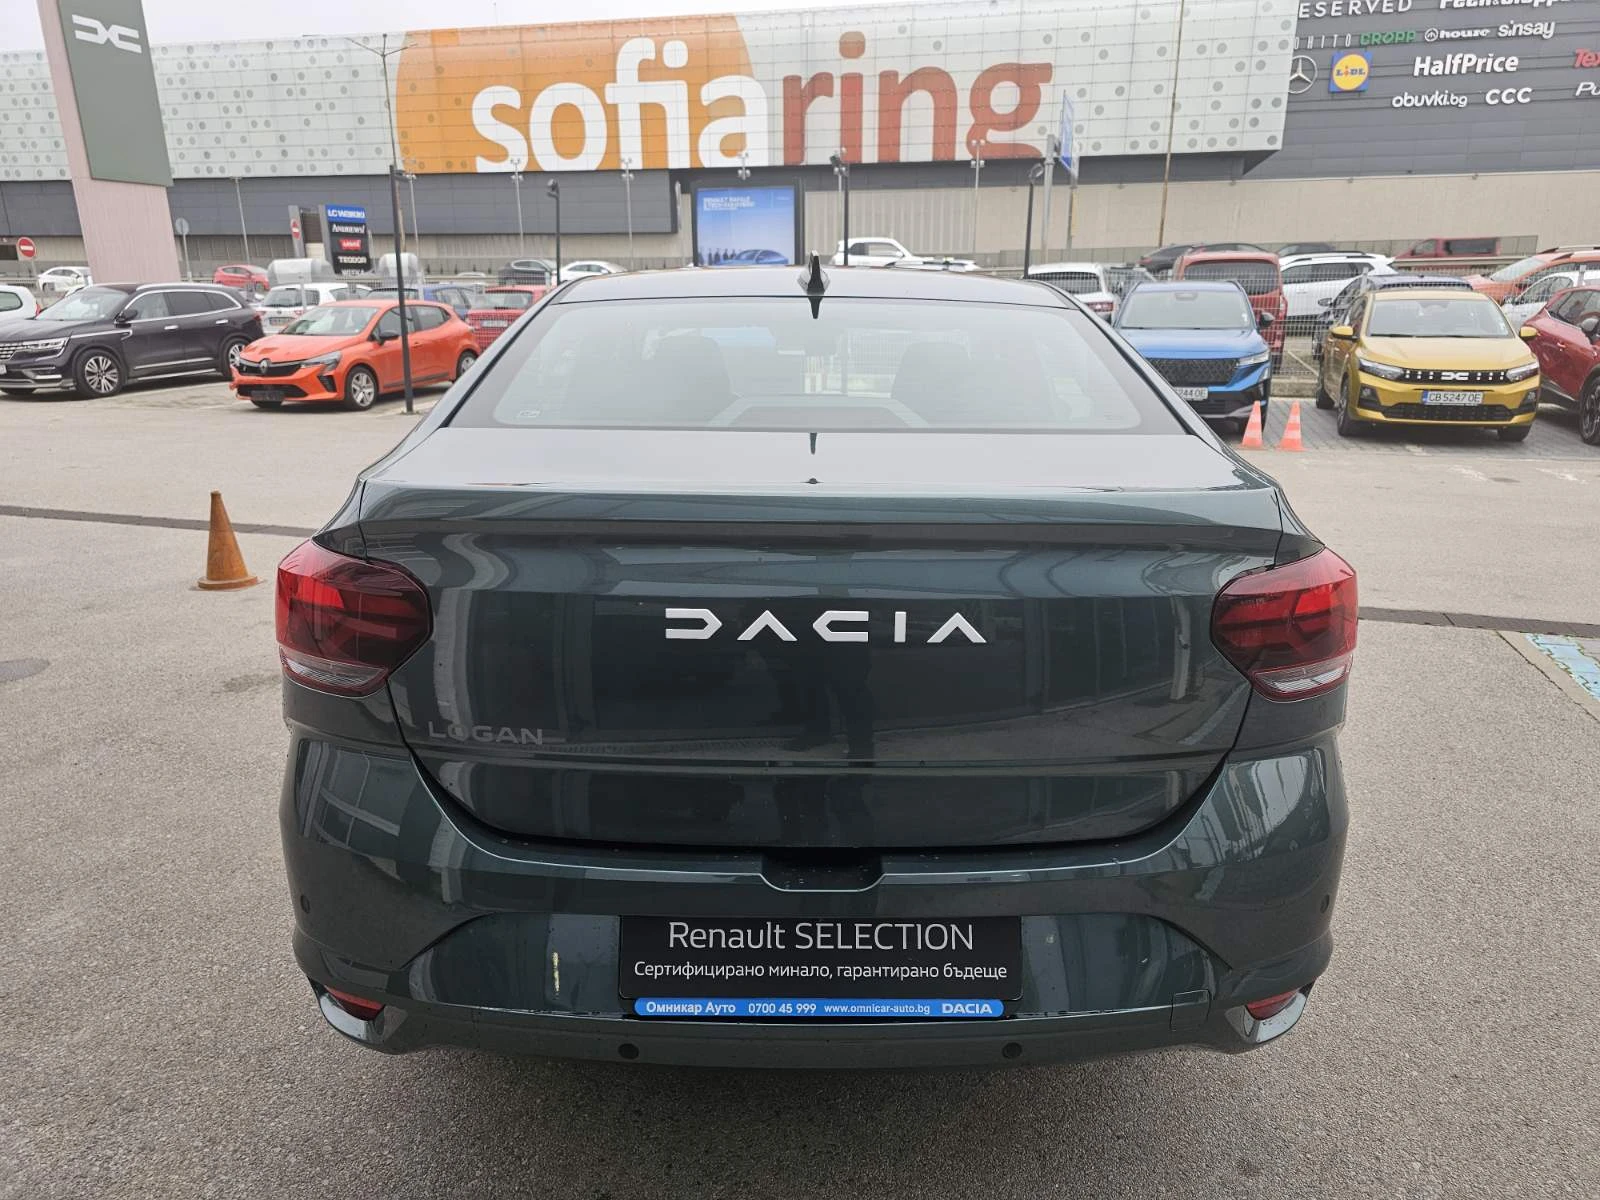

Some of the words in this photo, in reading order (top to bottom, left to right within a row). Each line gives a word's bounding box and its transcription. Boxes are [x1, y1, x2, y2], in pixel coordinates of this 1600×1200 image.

[1413, 53, 1519, 76] HalfPrice
[1392, 90, 1468, 108] obuvki.bg
[1485, 87, 1532, 105] CCC
[1443, 393, 1466, 402] 5247
[665, 608, 987, 643] DACIA
[428, 721, 543, 745] LOGAN
[669, 921, 786, 949] Renault
[795, 922, 973, 950] SELECTION
[634, 961, 765, 980] Сертифицирано
[768, 965, 833, 979] минало,
[837, 965, 939, 980] гарантирано
[943, 963, 1007, 979] бъдеще
[646, 1001, 703, 1015] Омникар
[705, 1001, 736, 1015] Ауто
[748, 1003, 776, 1014] 0700
[778, 1003, 793, 1014] 45
[796, 1003, 817, 1014] 999
[824, 1003, 930, 1014] www.omnicar-auto.bg
[942, 1003, 992, 1014] DACIA
